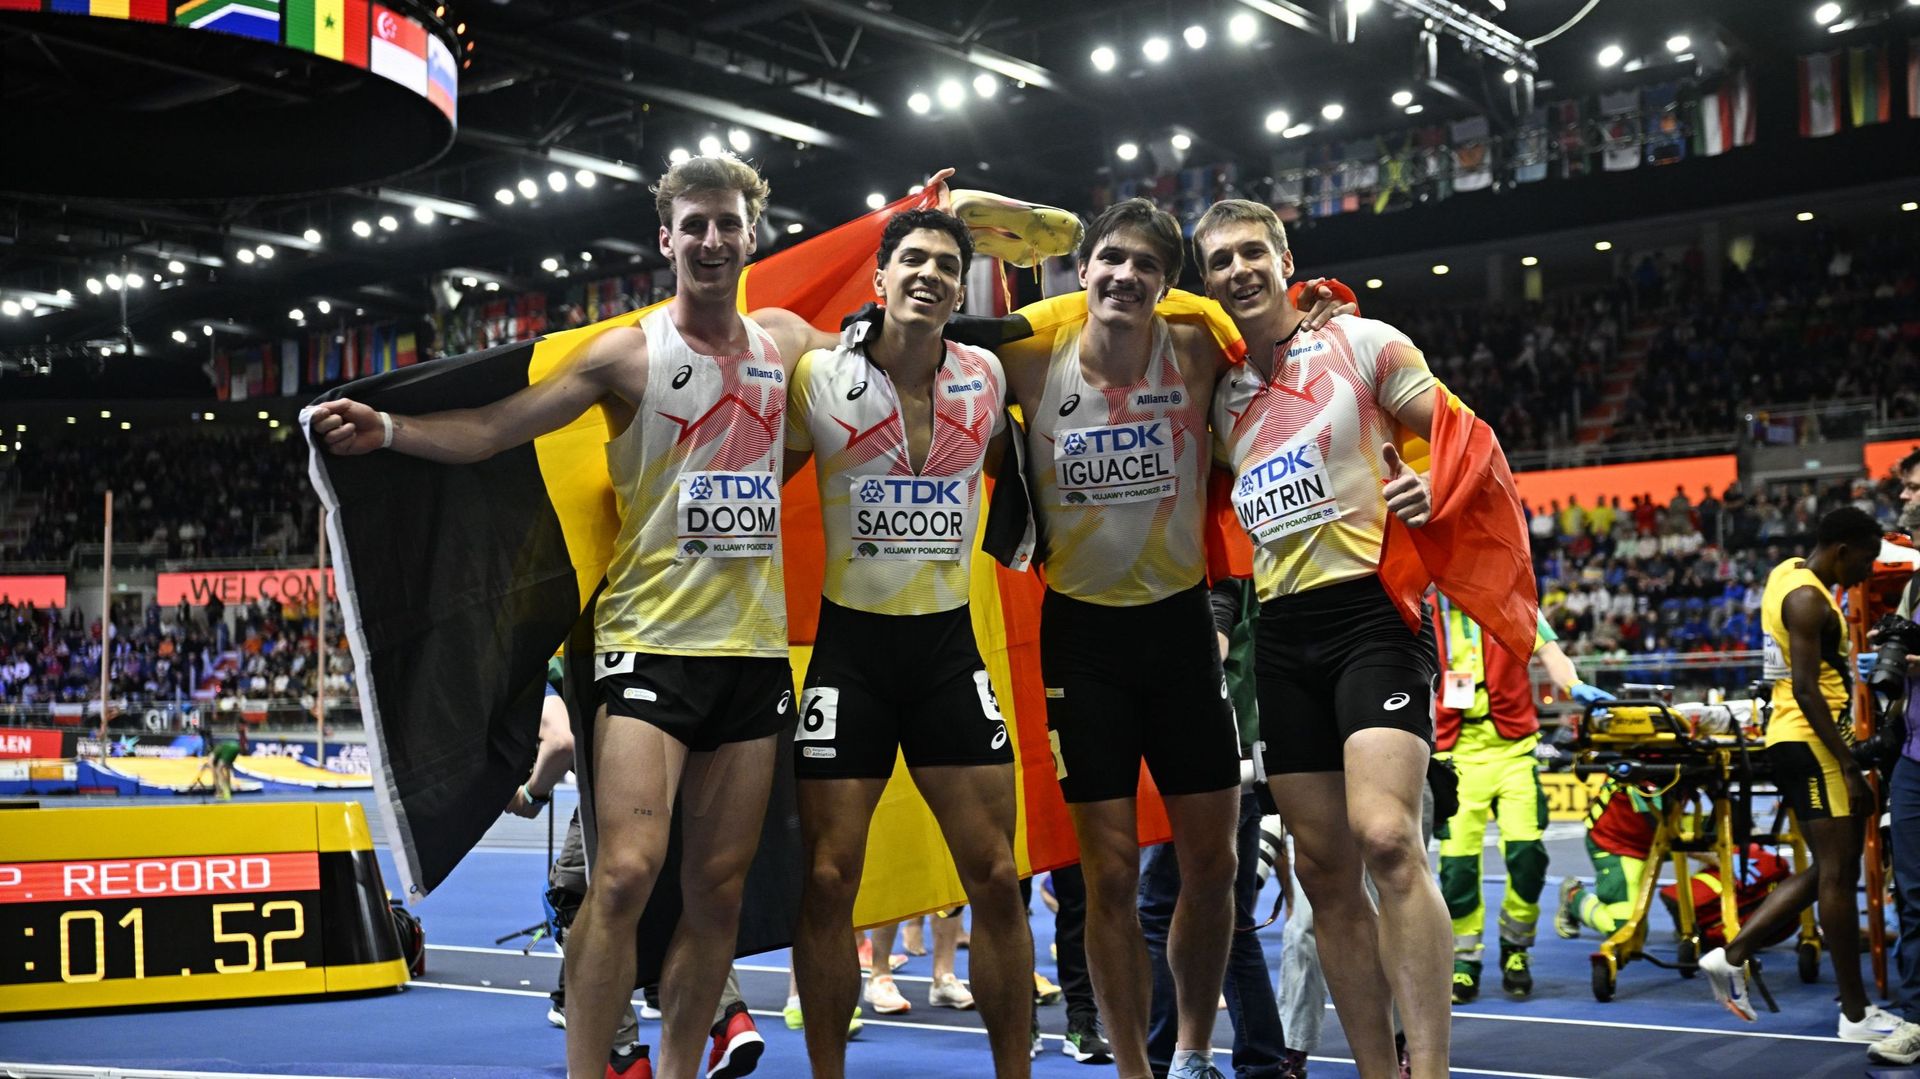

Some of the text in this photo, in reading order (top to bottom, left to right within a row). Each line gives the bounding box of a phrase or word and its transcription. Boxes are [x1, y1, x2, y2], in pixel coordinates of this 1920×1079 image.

[1287, 346, 1312, 357] Allianz
[746, 367, 774, 379] Allianz
[948, 383, 972, 394] Allianz
[1137, 394, 1169, 405] Allianz
[1085, 422, 1164, 453] TDK
[1062, 453, 1169, 486] IGUACEL
[1251, 444, 1315, 488] TDK
[713, 475, 775, 500] TDK
[884, 480, 961, 505] TDK
[1092, 491, 1123, 500] KUJAWY
[1125, 486, 1161, 498] POMORZE
[1238, 473, 1326, 528] WATRIN
[687, 506, 775, 533] DOOM
[857, 510, 963, 537] SACOOR
[1260, 524, 1285, 538] KUJAWY
[1286, 511, 1322, 528] POMORZE
[713, 543, 746, 552] KUJAWY
[883, 547, 917, 555] KUJAWY
[803, 694, 824, 733] 6
[64, 857, 271, 897] RECORD
